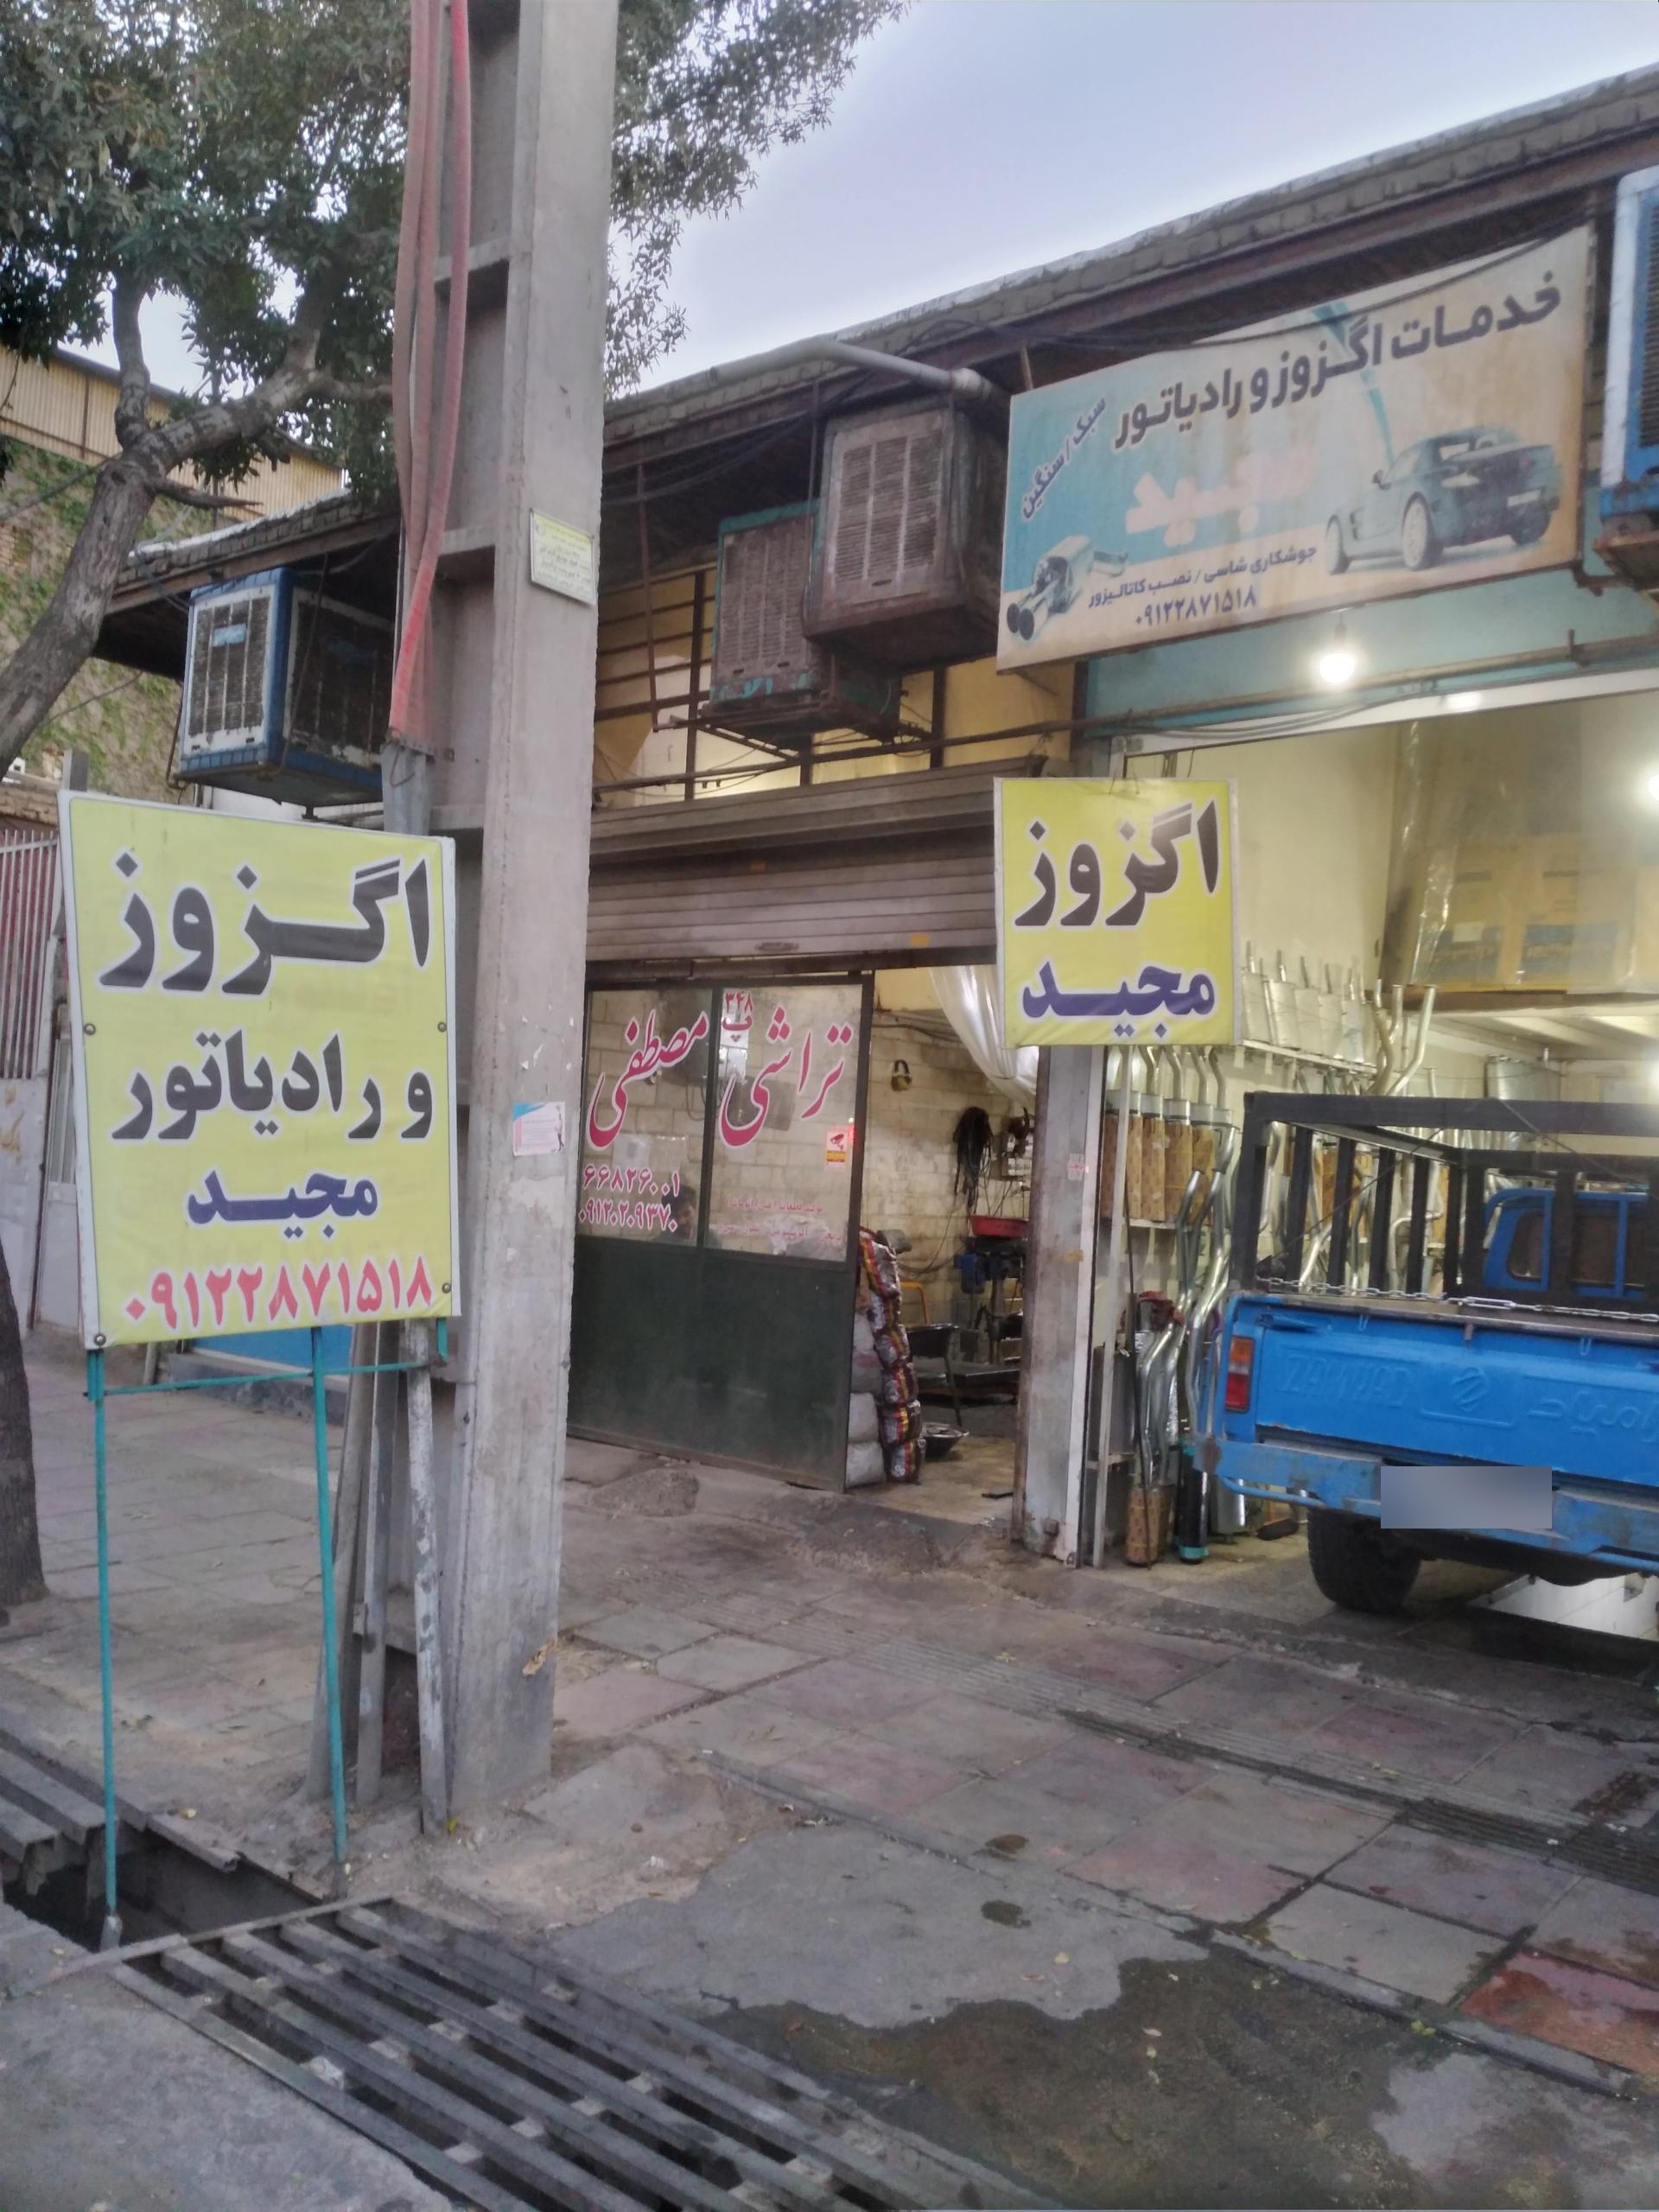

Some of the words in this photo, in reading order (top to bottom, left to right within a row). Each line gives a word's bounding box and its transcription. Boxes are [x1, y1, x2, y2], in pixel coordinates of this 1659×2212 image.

[1390, 270, 1561, 359] خدمات
[1250, 367, 1268, 412] و
[1272, 315, 1383, 408] اگزوز
[1073, 397, 1105, 445] سبک
[1114, 366, 1243, 449] رادیاتور
[1023, 454, 1065, 518] سنگین
[1088, 579, 1147, 608] کاتالیزور
[1148, 570, 1193, 595] نصب
[1204, 556, 1247, 582] شاسی
[1250, 545, 1318, 574] جوشکاری
[1135, 586, 1257, 626] ۰۹۱۲۲۸۷۱۵۱۸
[1014, 799, 1219, 926] اگزوز
[99, 851, 430, 995] اگزوز
[1022, 961, 1215, 1038] مجید
[112, 1029, 383, 1140] رادیاتور
[400, 1071, 433, 1140] و
[588, 1008, 709, 1148] مصطفی
[721, 1005, 853, 1147] تراشی
[188, 1169, 378, 1239] مجید
[125, 1256, 432, 1329] ۰۹۱۲۲۸۷۱۵۱۸
